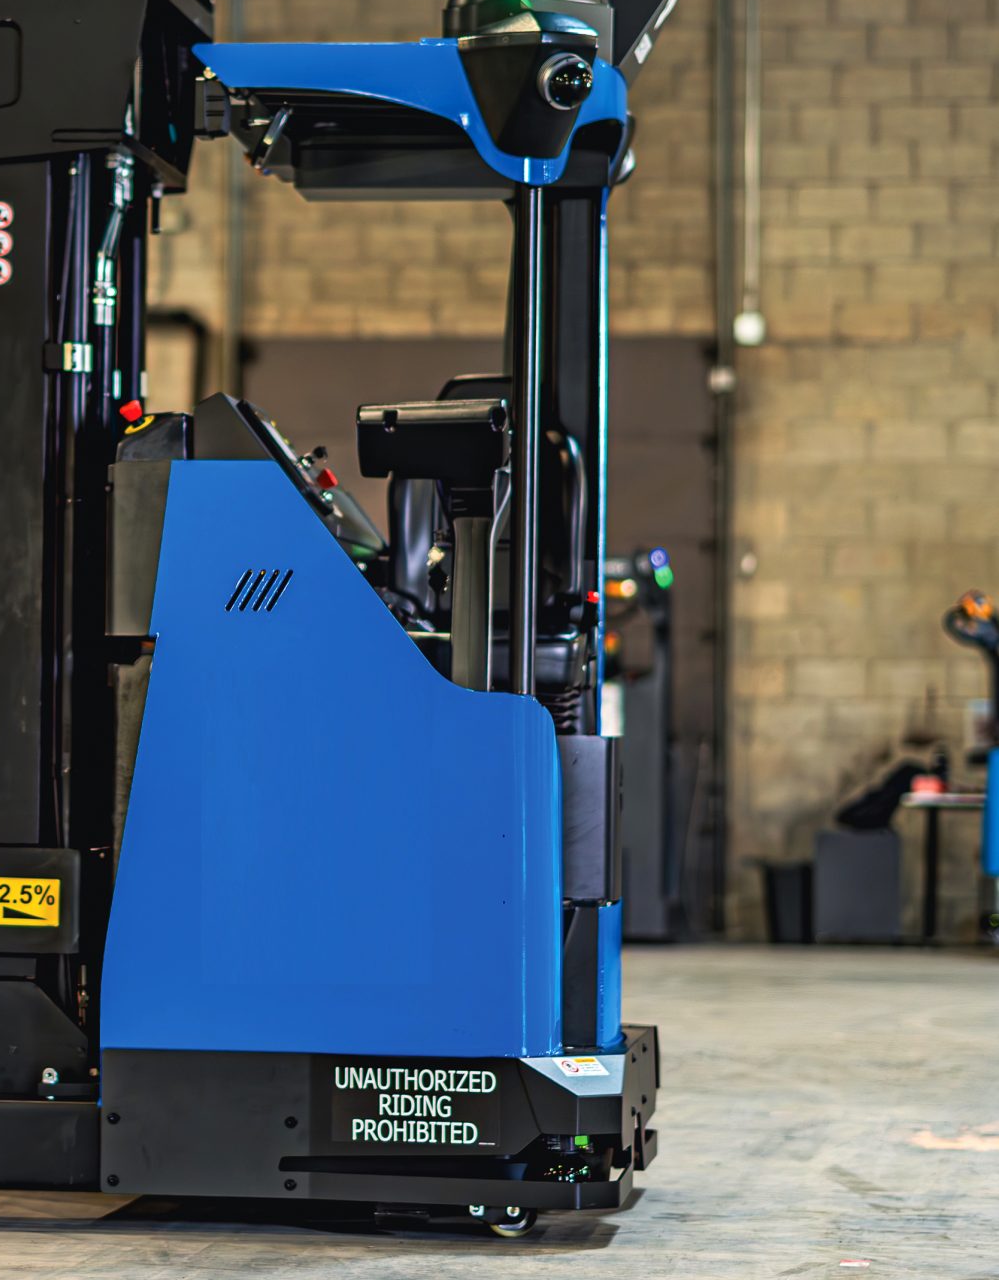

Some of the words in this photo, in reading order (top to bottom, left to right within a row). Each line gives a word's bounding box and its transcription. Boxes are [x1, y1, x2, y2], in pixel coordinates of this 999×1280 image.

[335, 1066, 497, 1093] UNAUTHORIZED
[379, 1094, 452, 1118] RIDING
[352, 1118, 478, 1145] PROHIBITED
